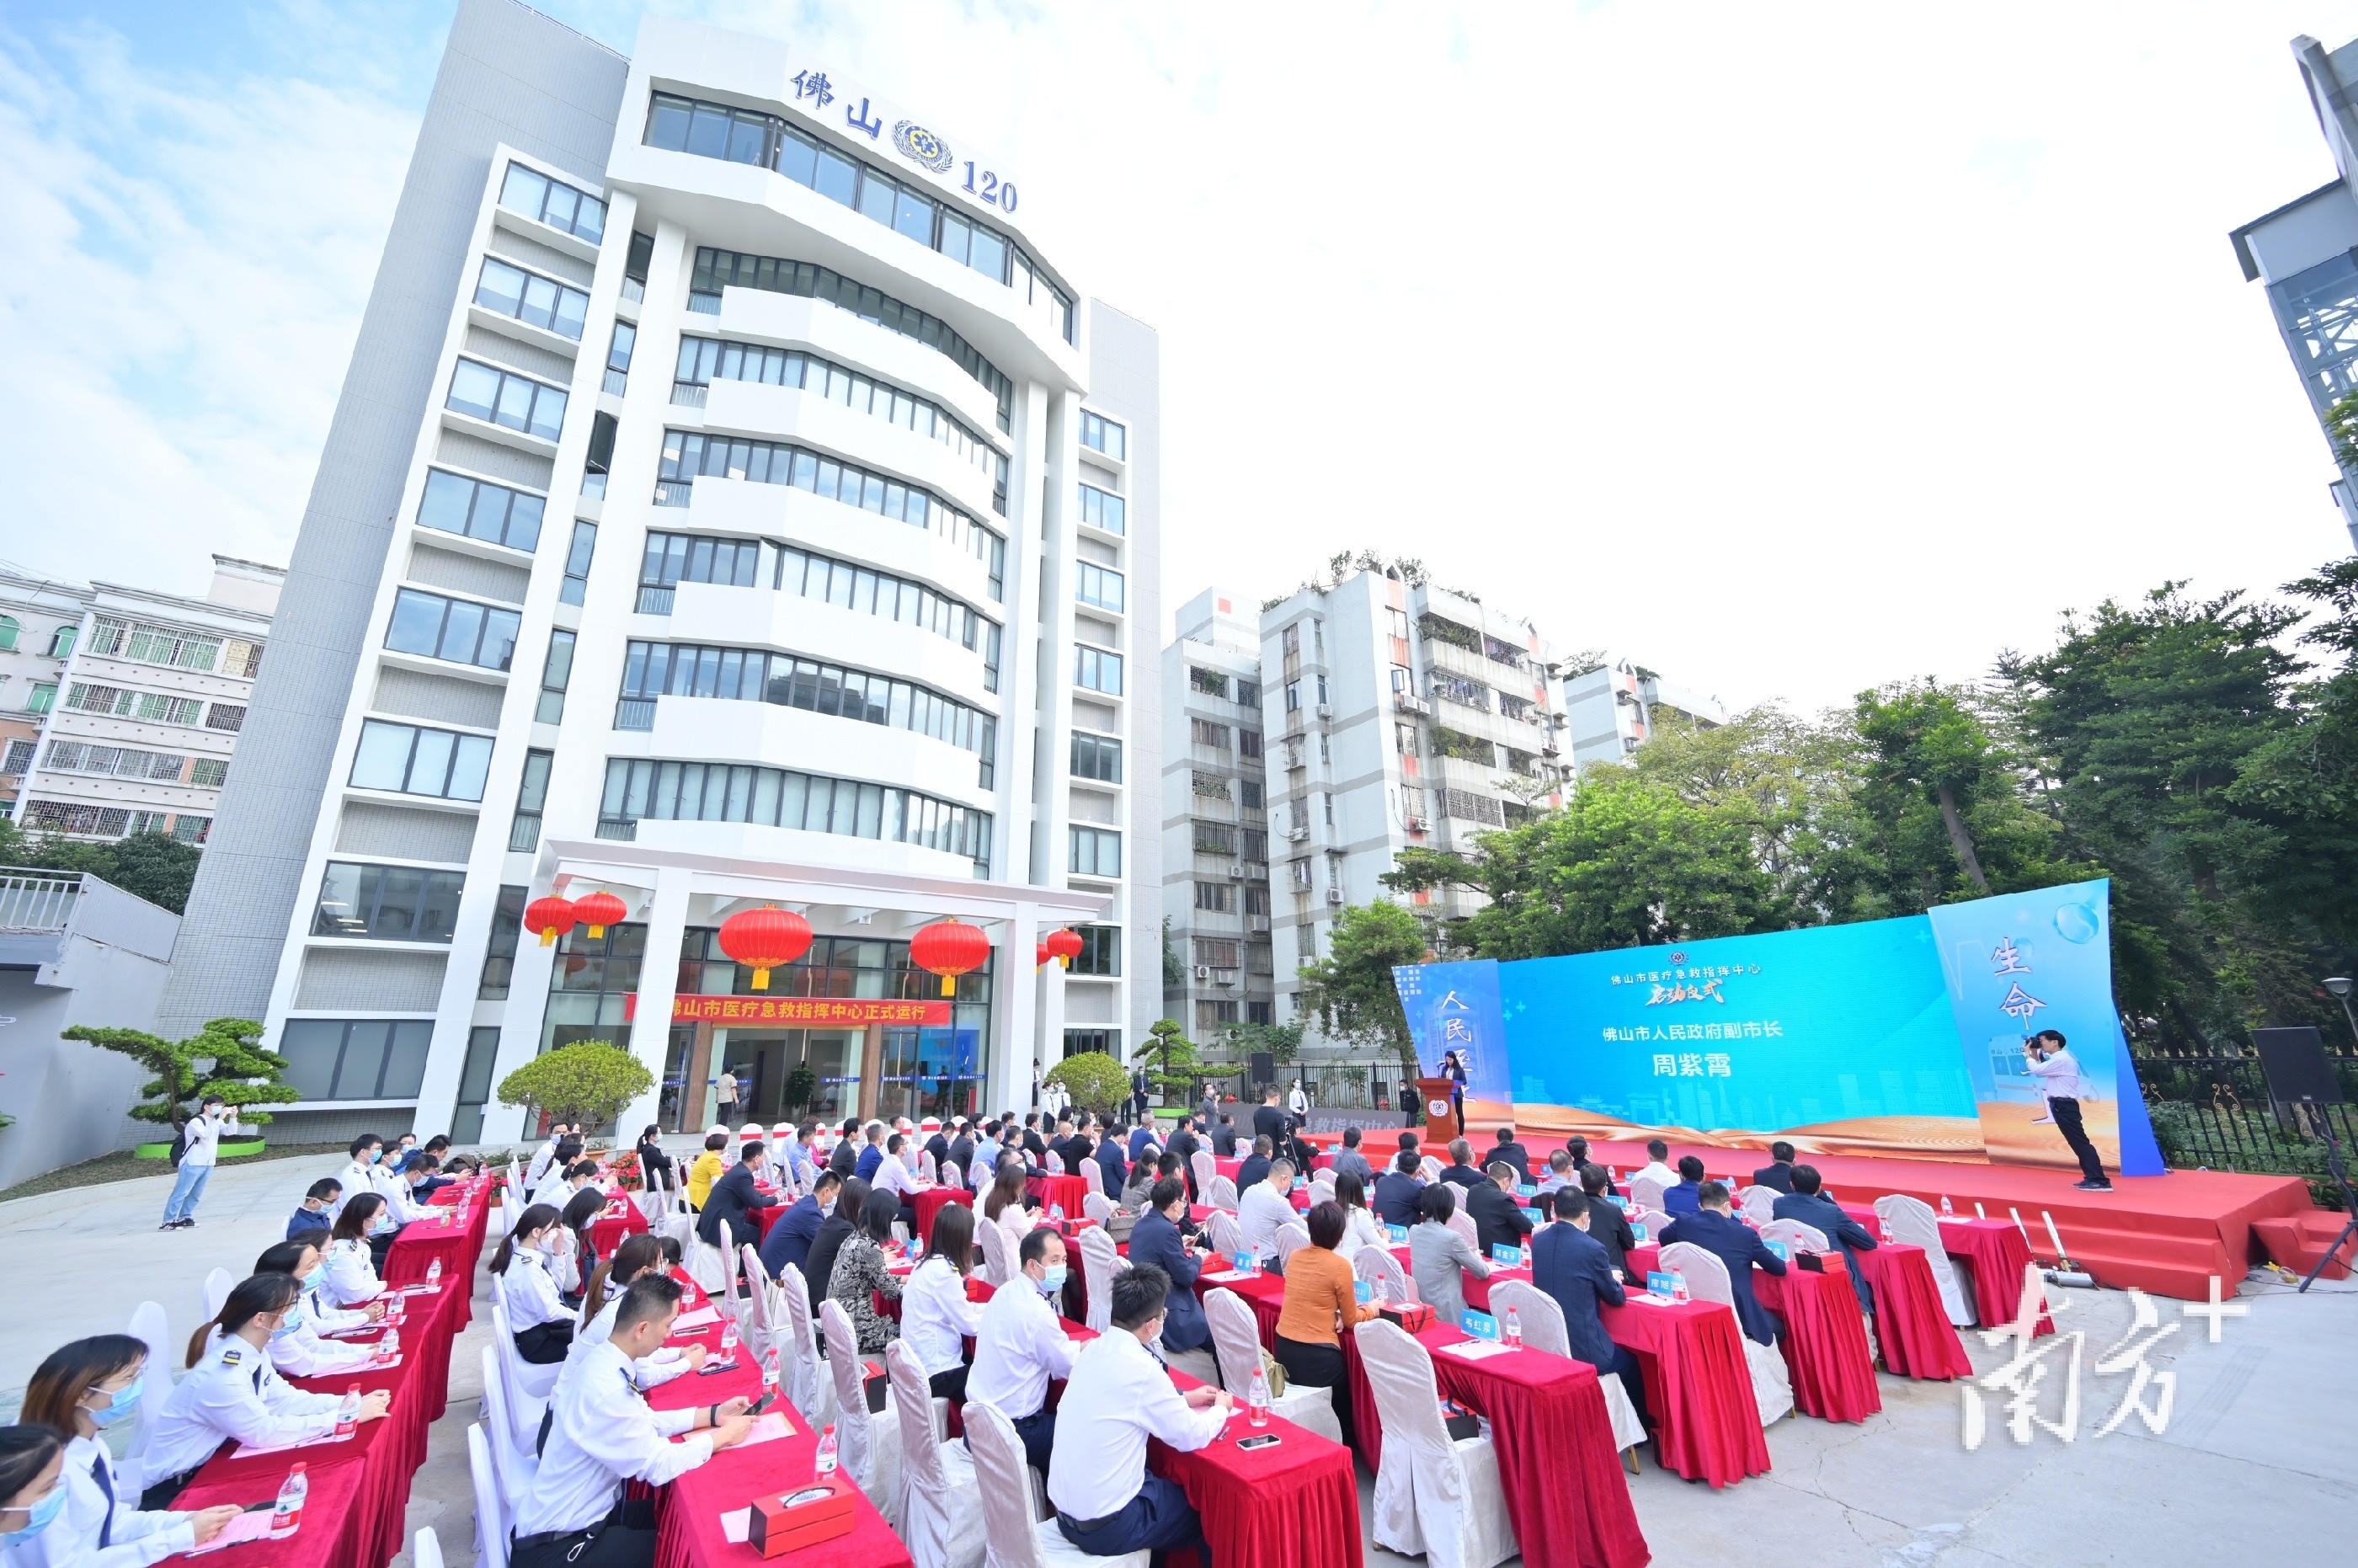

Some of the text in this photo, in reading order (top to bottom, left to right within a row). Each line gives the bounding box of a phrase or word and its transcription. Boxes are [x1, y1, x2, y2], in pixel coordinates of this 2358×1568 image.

[791, 69, 1018, 214] 佛山 120
[1610, 963, 1761, 986] 佛山市医疗急救指挥中心
[1646, 979, 1725, 1005] 启动仪式
[1603, 1020, 1784, 1042] 佛山市人民政府副市长
[1652, 1053, 1731, 1077] 周紫霄
